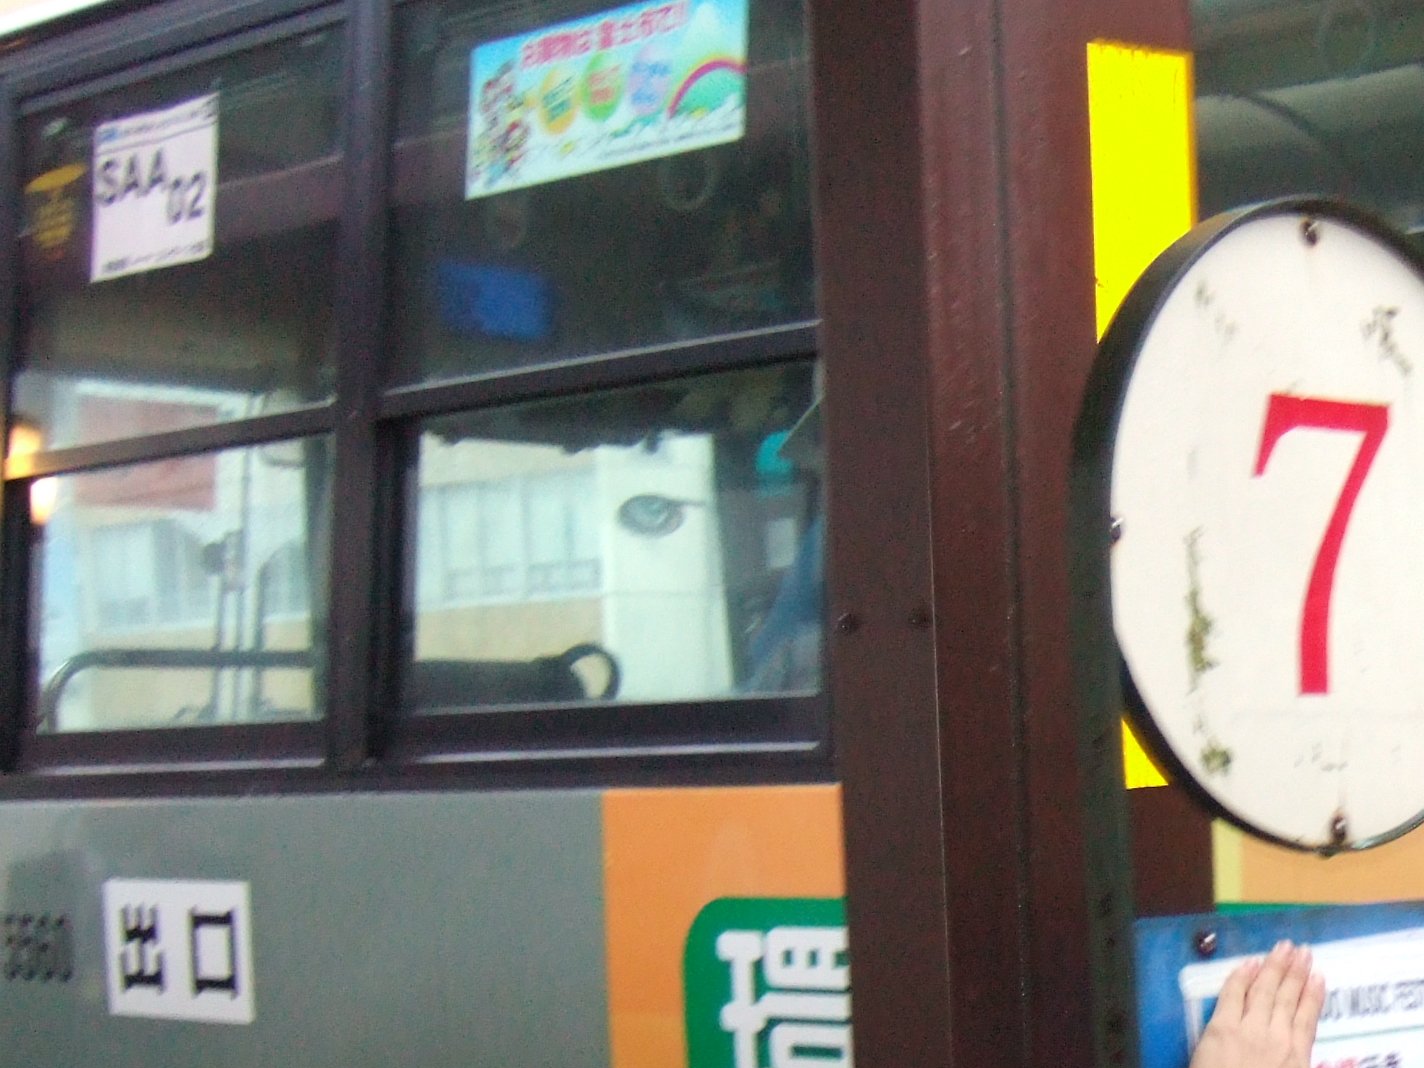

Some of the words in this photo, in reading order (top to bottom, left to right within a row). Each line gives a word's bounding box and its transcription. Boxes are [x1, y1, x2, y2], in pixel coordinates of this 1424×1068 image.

[100, 148, 166, 208] SAA
[168, 171, 207, 226] 02
[1252, 393, 1391, 697] 7
[119, 903, 239, 1000] 出口
